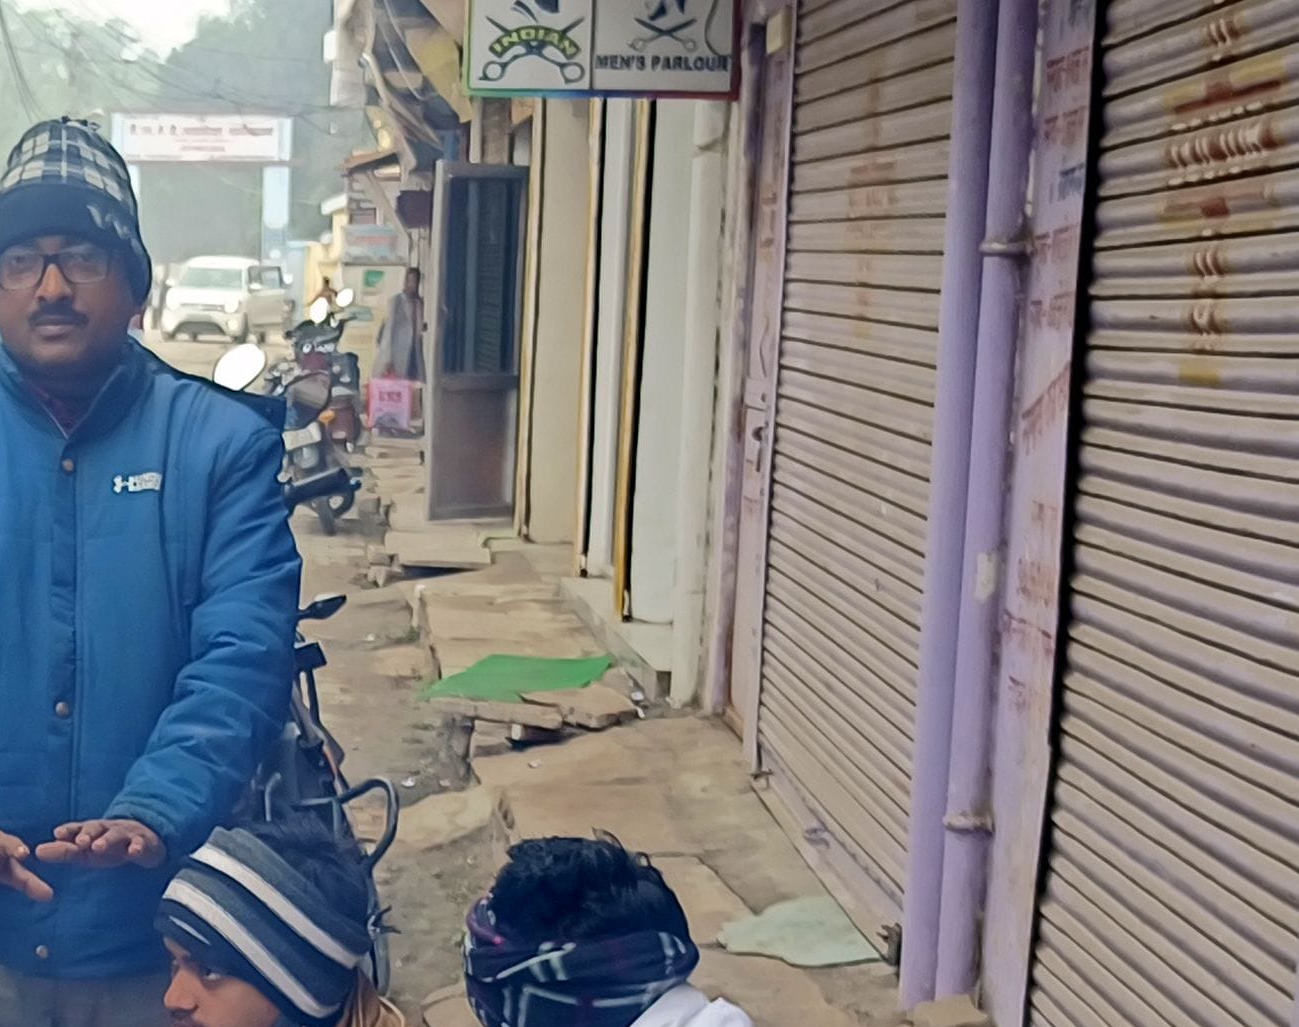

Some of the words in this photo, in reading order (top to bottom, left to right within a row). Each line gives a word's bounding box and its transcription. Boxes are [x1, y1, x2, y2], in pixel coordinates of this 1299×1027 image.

[492, 28, 579, 55] INDIAN
[595, 55, 646, 72] MEN'S
[651, 55, 729, 72] PARLOUR
